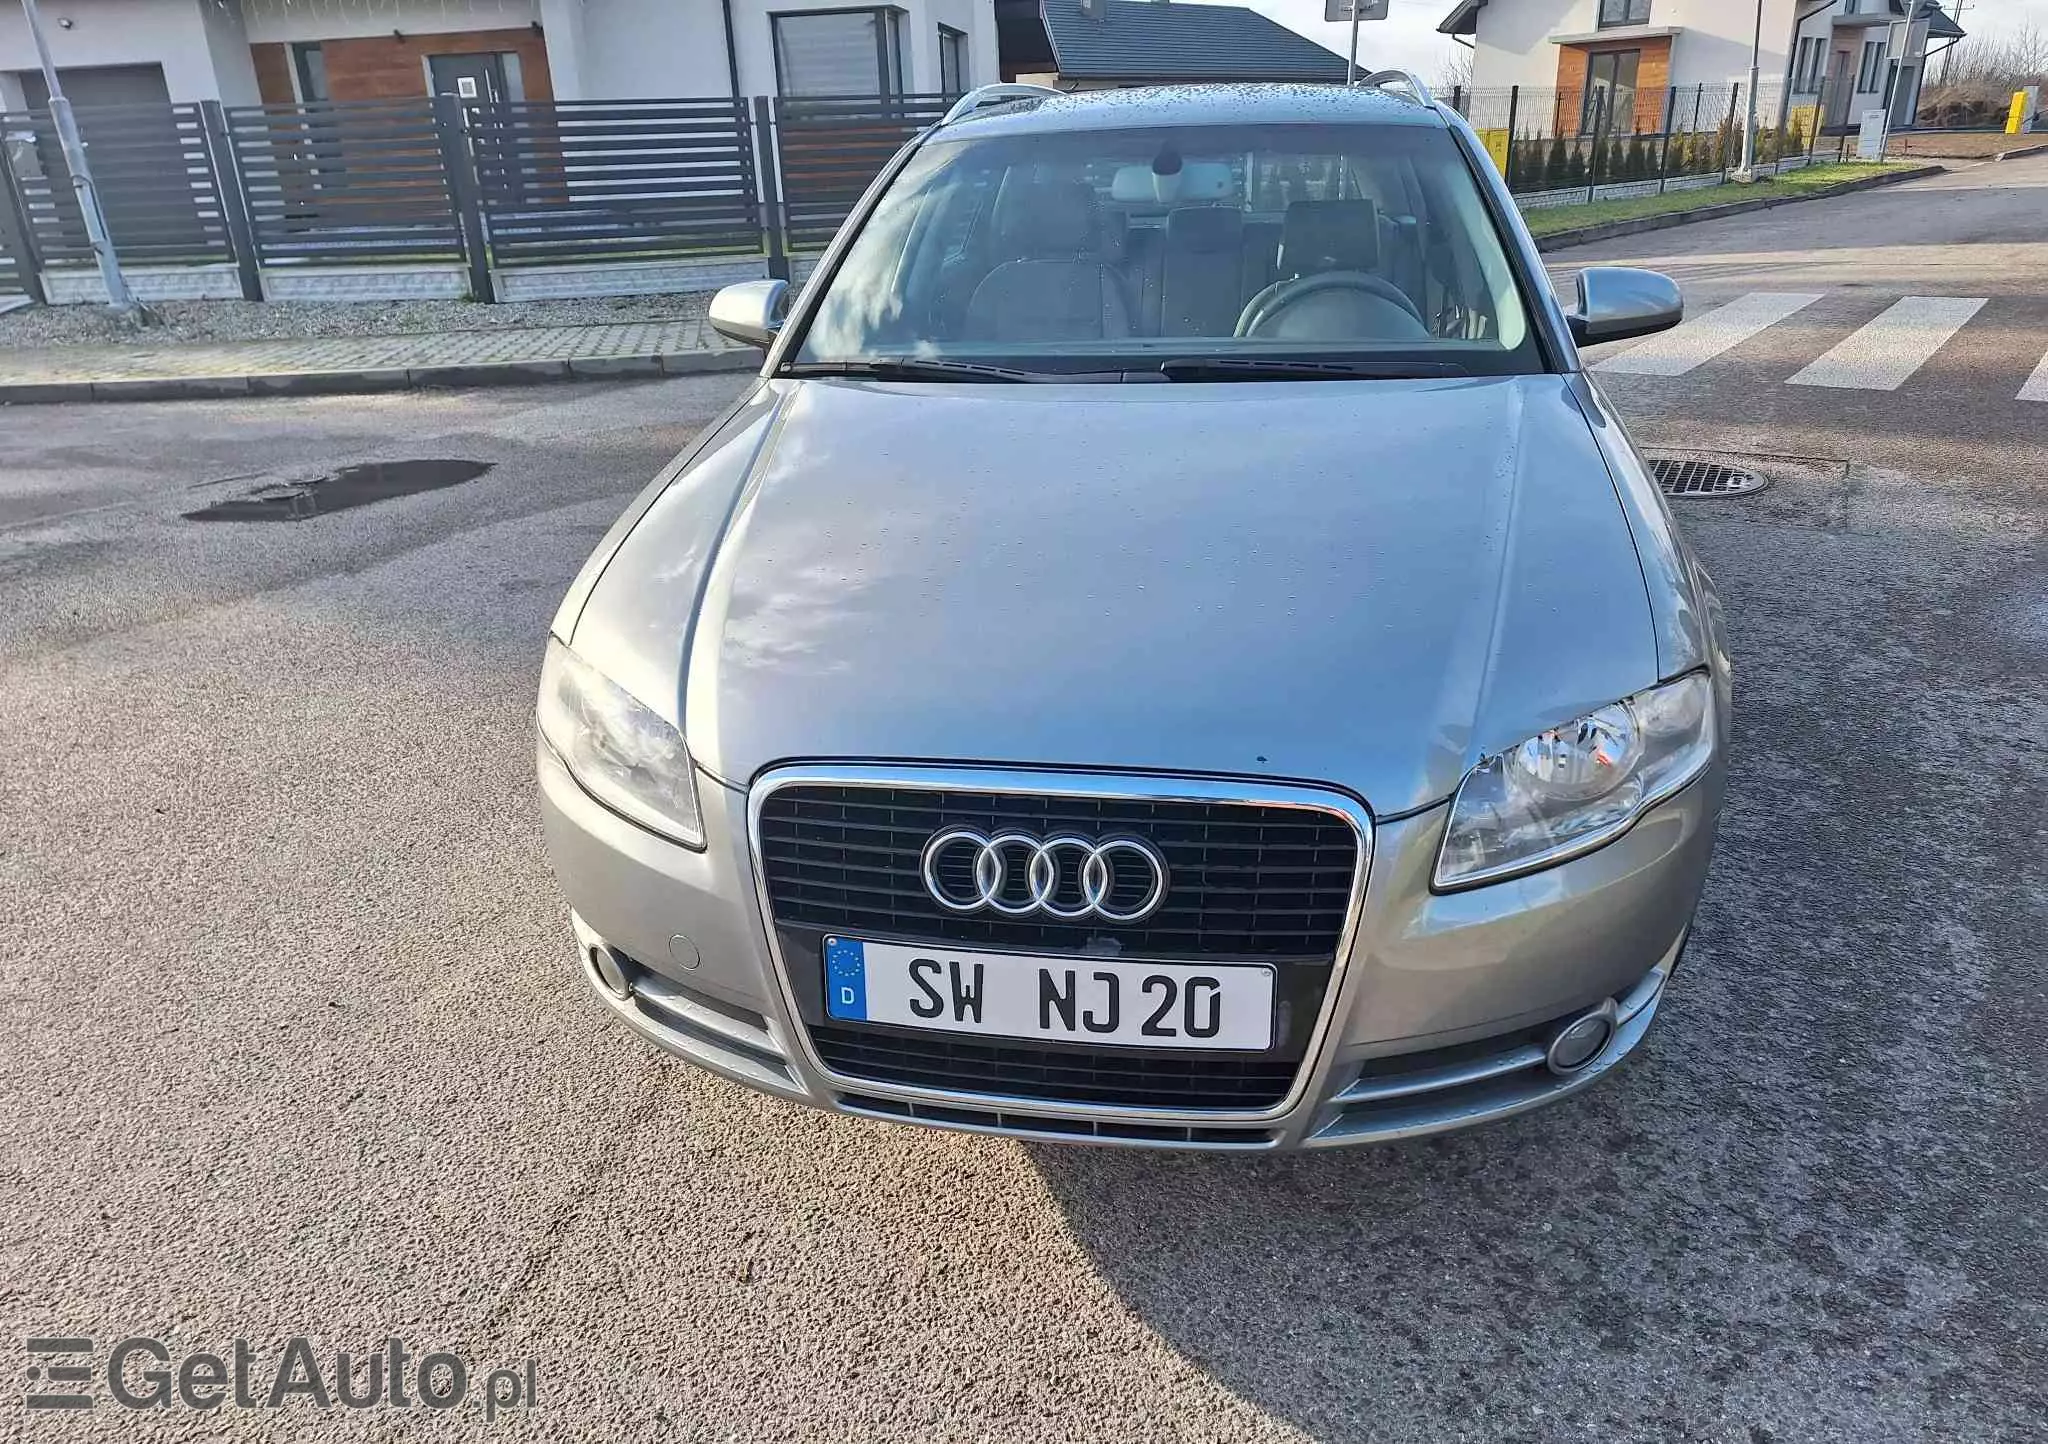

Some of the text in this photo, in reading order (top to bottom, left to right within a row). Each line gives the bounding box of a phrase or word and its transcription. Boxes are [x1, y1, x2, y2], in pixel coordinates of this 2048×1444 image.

[841, 986, 855, 1005] D
[908, 959, 1221, 1038] SW NJ 20
